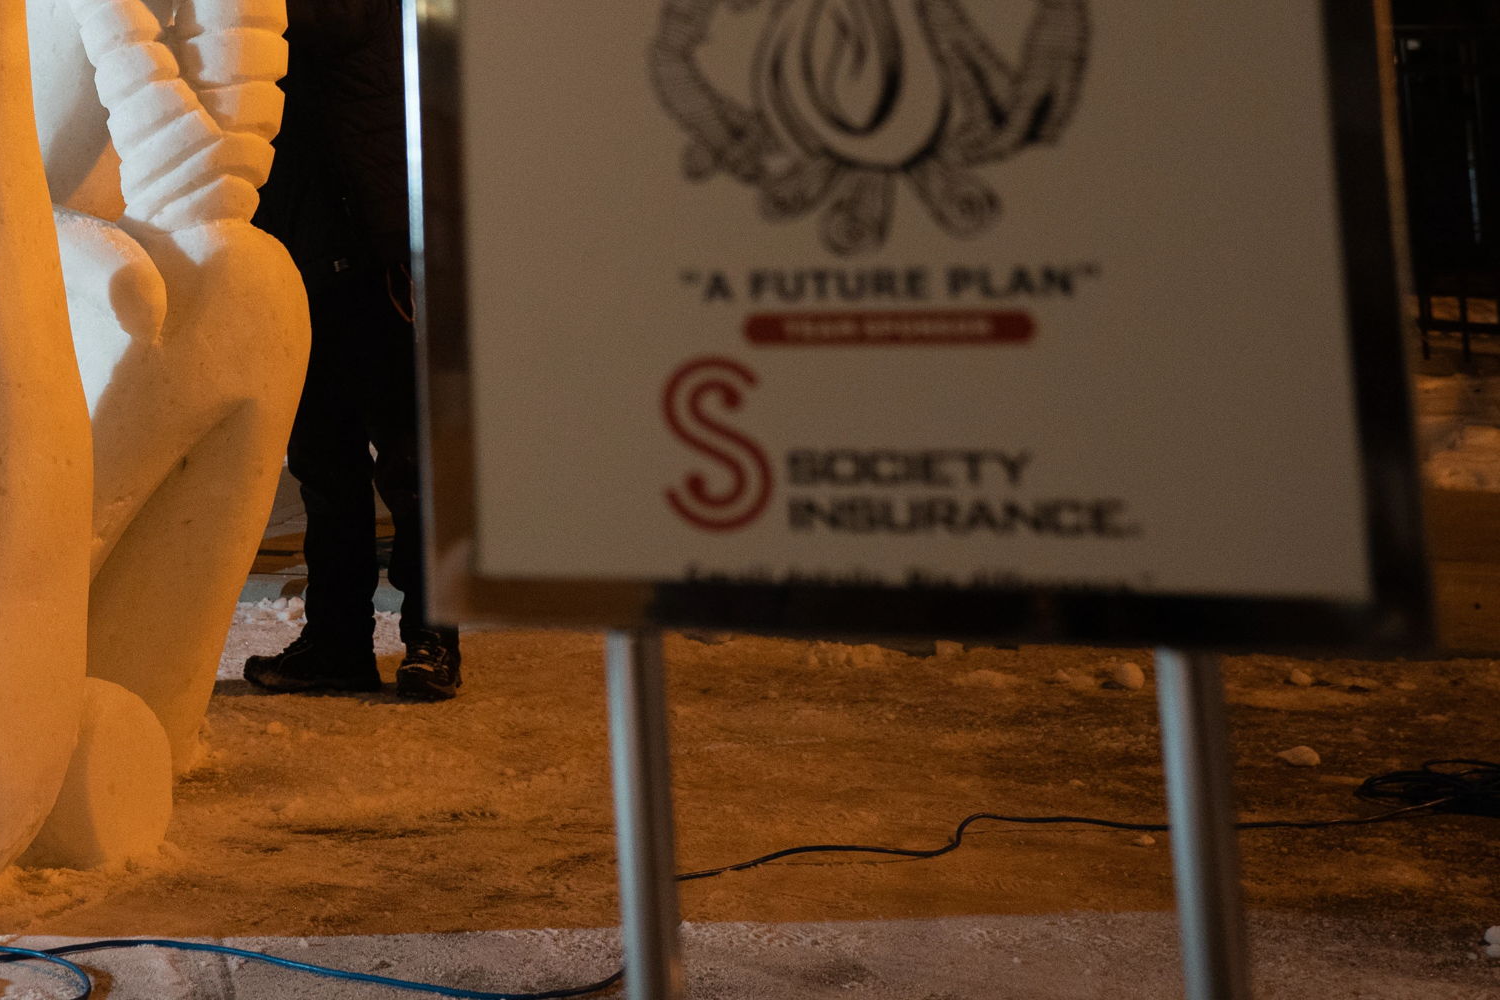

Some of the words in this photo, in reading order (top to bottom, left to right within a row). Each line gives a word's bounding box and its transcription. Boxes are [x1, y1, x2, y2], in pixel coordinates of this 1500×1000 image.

[748, 266, 928, 300] FUTURE
[946, 262, 1102, 299] PLAN"
[786, 447, 1033, 487] SOCIETY
